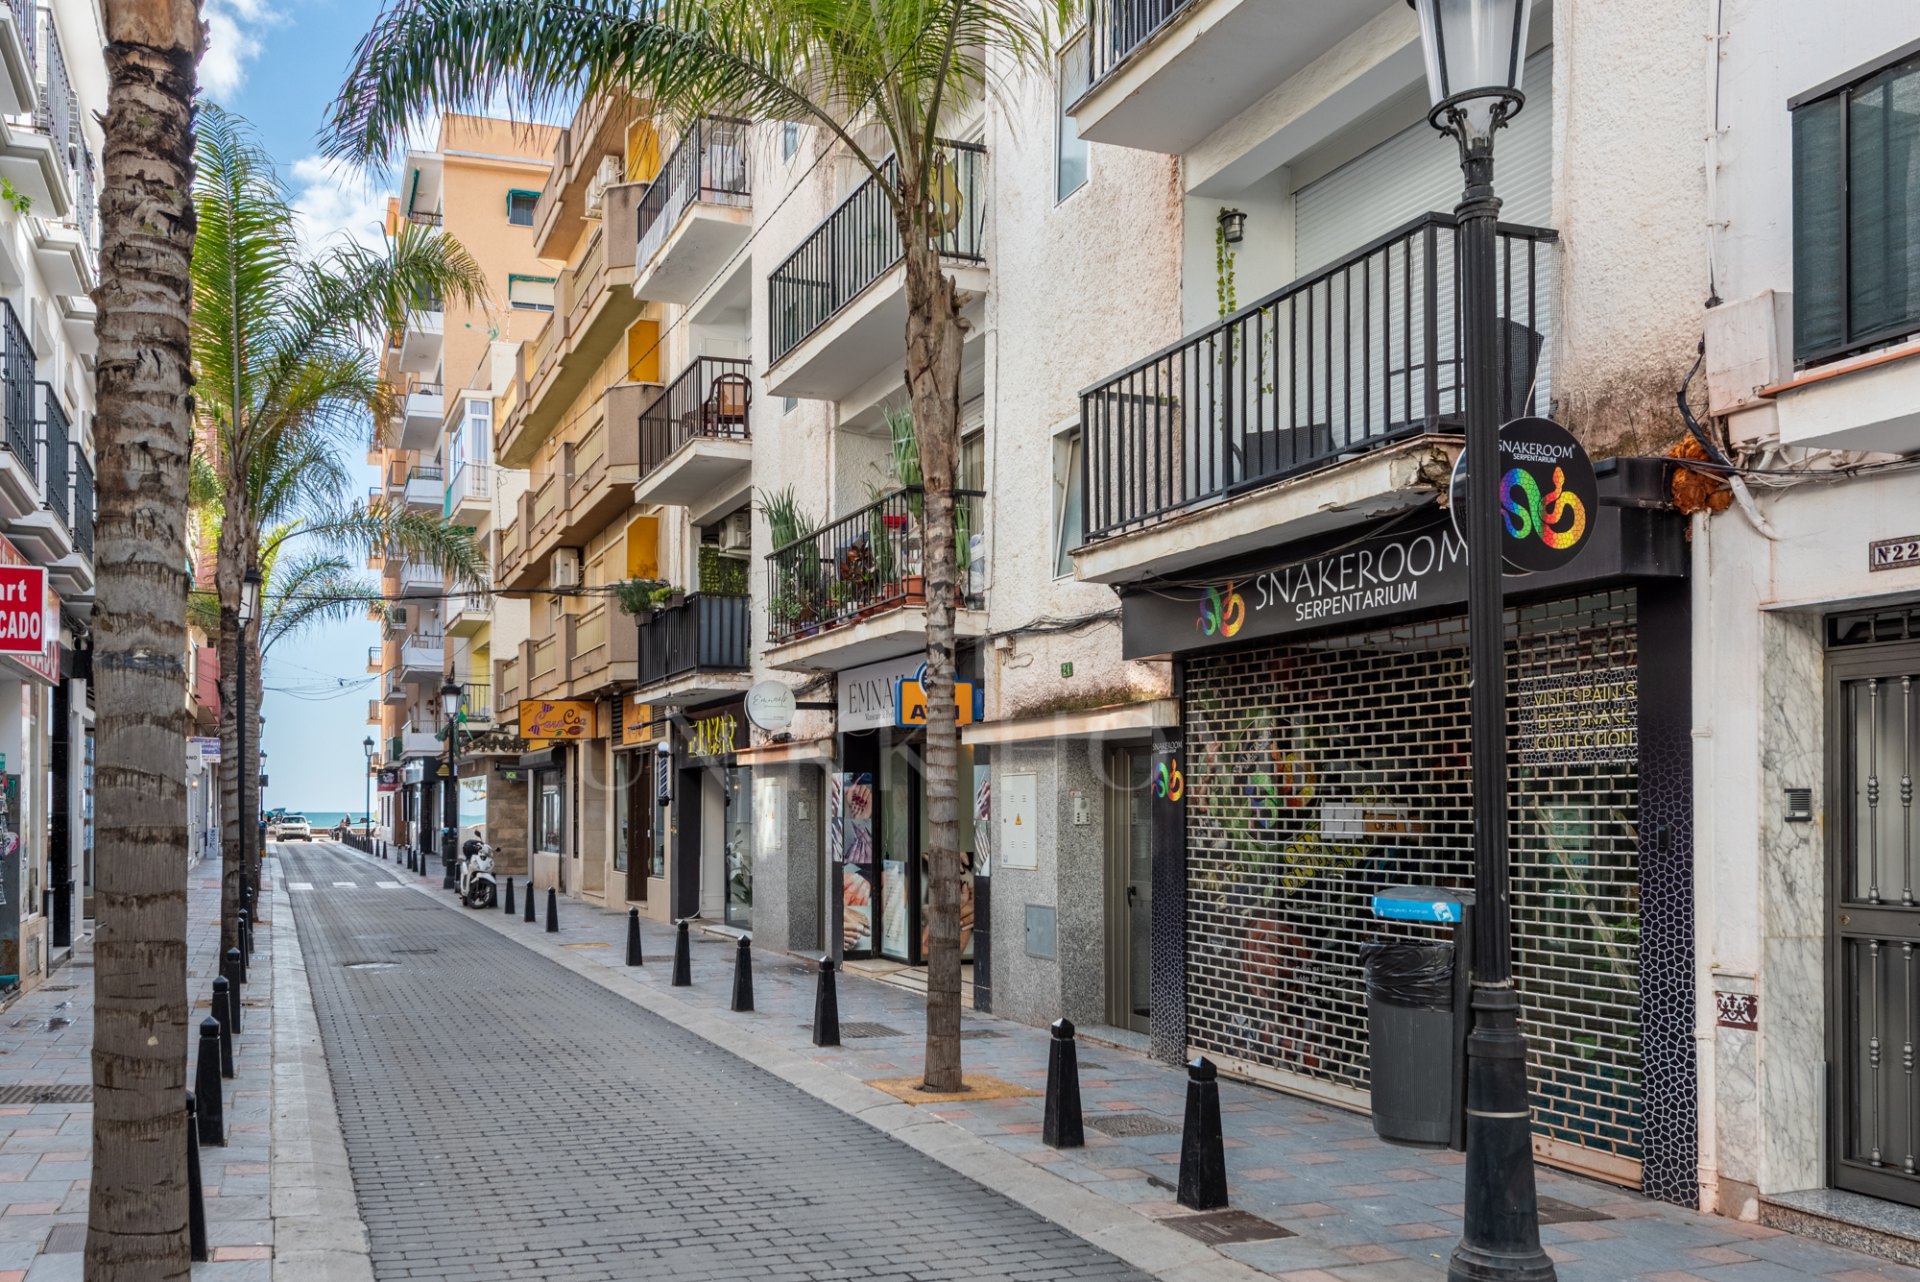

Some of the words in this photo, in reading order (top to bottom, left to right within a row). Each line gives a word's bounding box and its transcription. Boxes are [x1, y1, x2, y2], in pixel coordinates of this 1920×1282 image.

[1513, 453, 1557, 464] SERPENTARIUM
[1255, 528, 1469, 611] SNAKEROOM
[1295, 580, 1418, 622] SERPENTARIUM
[1538, 712, 1574, 729] BEST
[1537, 730, 1634, 750] COLLECTION
